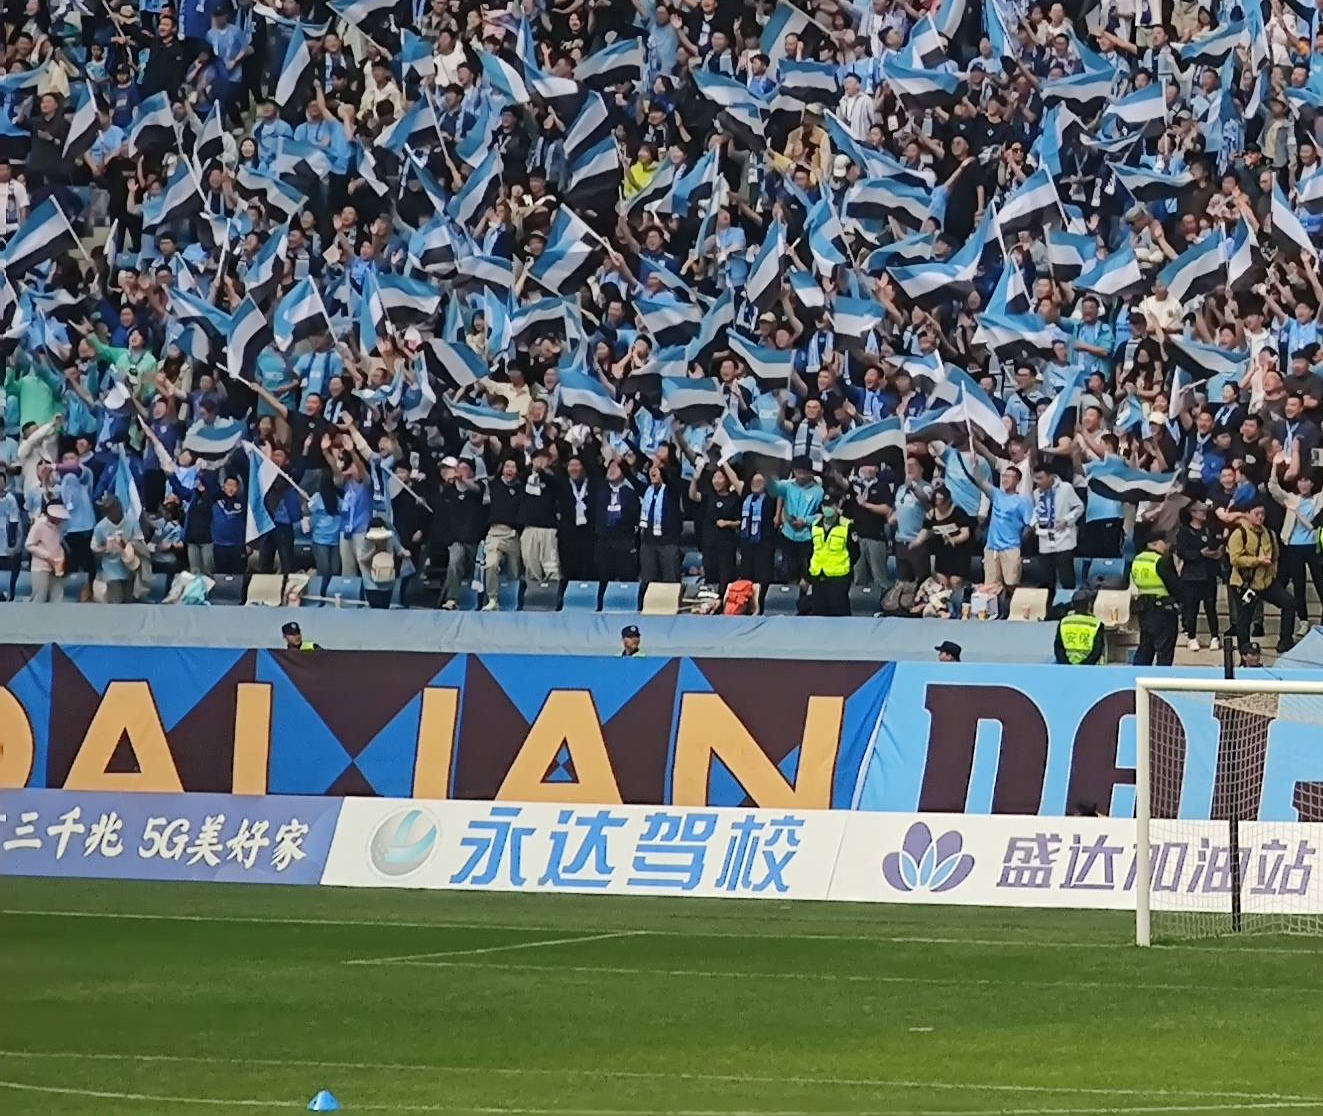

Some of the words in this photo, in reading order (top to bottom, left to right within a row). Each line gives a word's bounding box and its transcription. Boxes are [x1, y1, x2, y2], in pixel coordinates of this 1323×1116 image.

[1065, 630, 1091, 647] 安保
[0, 806, 124, 860] 三千兆
[138, 813, 310, 871] 5G美好家
[450, 806, 805, 892] 永达驾校
[996, 832, 1316, 896] 盛达加油站
